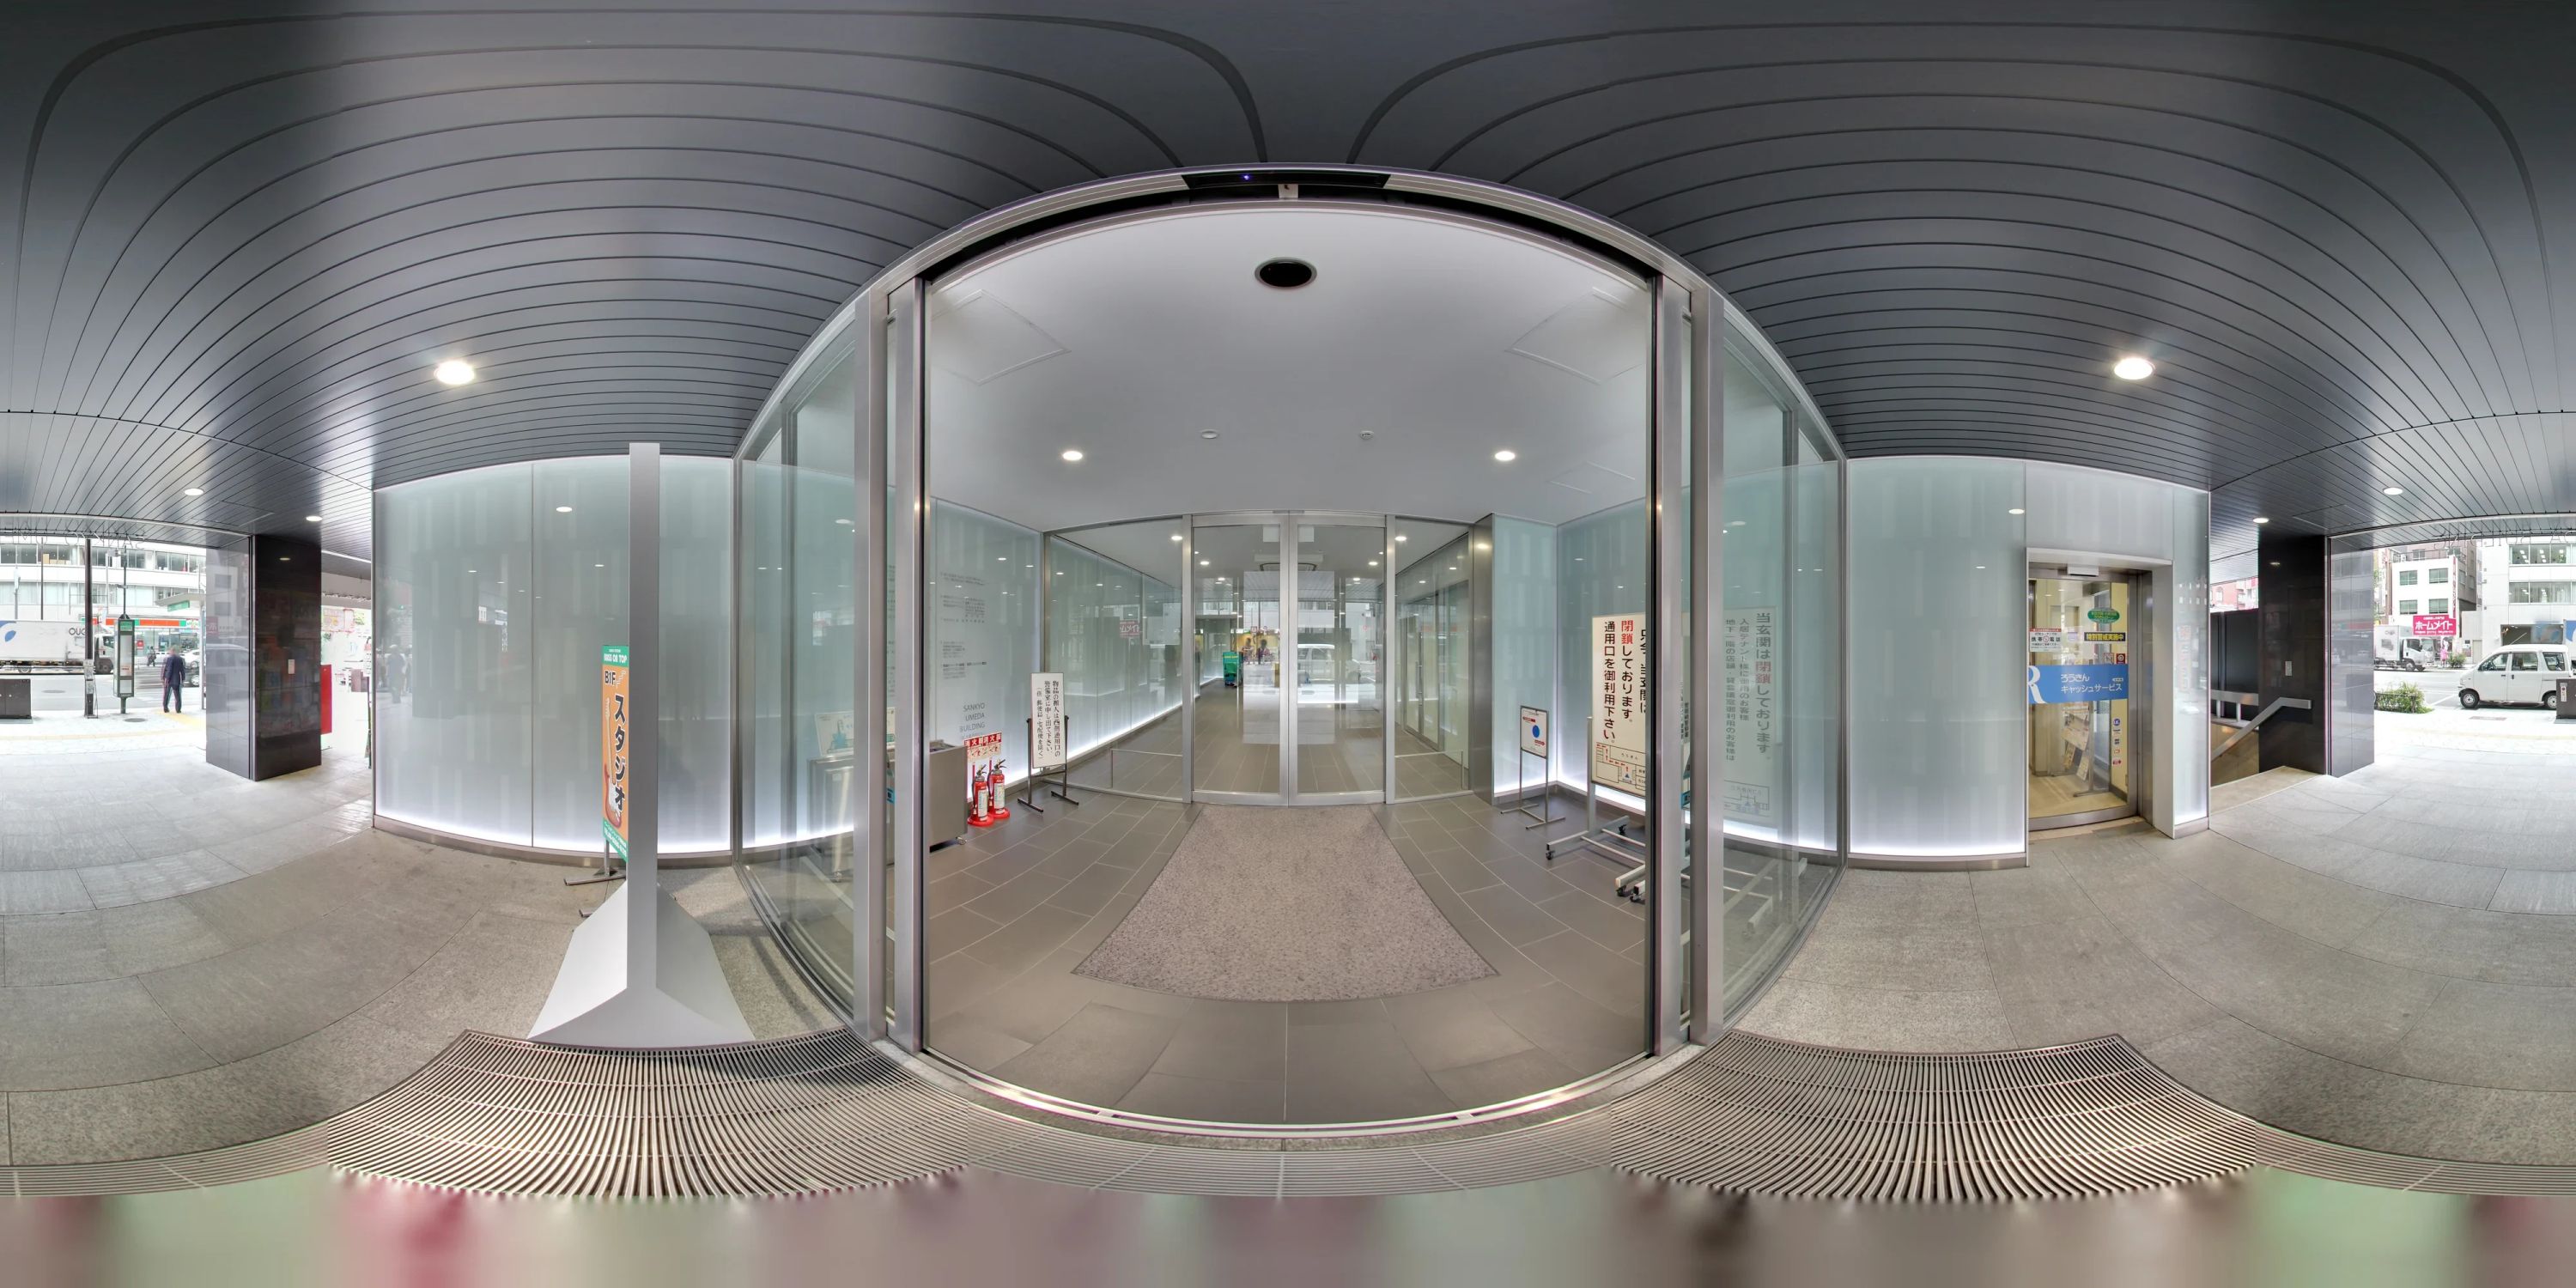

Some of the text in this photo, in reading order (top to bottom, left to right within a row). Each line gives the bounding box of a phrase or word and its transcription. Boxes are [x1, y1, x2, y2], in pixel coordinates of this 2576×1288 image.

[2415, 620, 2453, 631] ホームメイト
[618, 654, 628, 664] TOP
[1620, 620, 1634, 722] 閉鎖しております。
[605, 670, 616, 685] B1F
[1603, 621, 1616, 743] 通用口を御利用下さい。
[2060, 673, 2090, 683] ろうきん
[2060, 683, 2123, 694] キャッシュサービス
[963, 702, 986, 712] SANKYO
[965, 713, 985, 721] UMEDA
[959, 721, 986, 732] BUILDING
[613, 693, 626, 814] スタジオ
